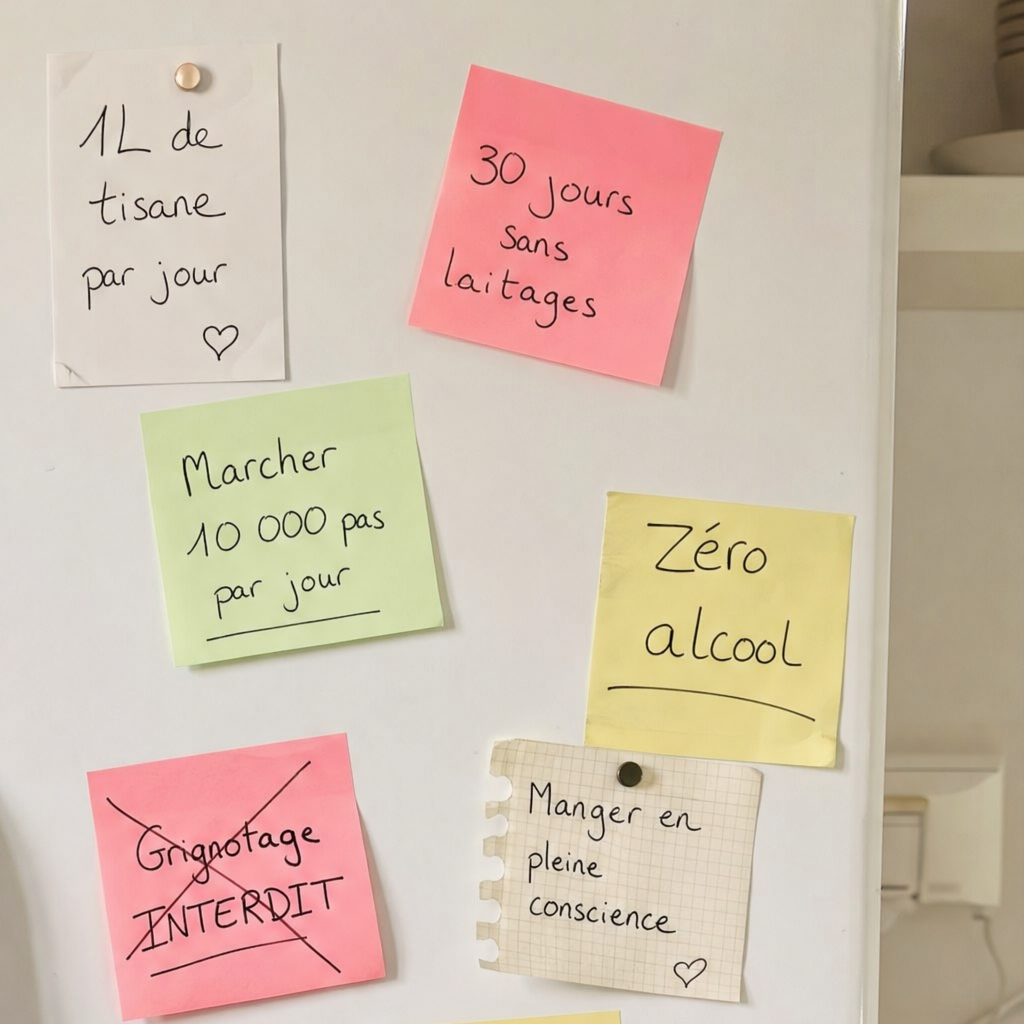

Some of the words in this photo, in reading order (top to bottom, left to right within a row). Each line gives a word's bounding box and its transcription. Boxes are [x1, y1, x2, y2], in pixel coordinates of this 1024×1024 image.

[78, 103, 152, 157] 1L
[171, 109, 224, 152] de
[88, 180, 227, 226] tisane
[470, 144, 527, 186] 30
[527, 175, 634, 220] jours
[499, 224, 569, 262] sans
[81, 266, 135, 311] par
[149, 260, 228, 306] jour
[444, 246, 598, 328] laitages
[181, 436, 337, 498] Marcher
[186, 521, 241, 557] 10
[257, 505, 327, 543] 000
[341, 510, 385, 548] pas
[646, 521, 768, 575] Zéro
[213, 579, 263, 620] par
[282, 567, 351, 613] jour
[645, 605, 803, 667] alcool
[528, 781, 642, 842] Manger
[658, 810, 702, 832] en
[136, 820, 320, 884] Grignotage
[527, 839, 603, 884] pleine
[133, 877, 345, 952] INTERDIT
[529, 896, 677, 934] conscience
